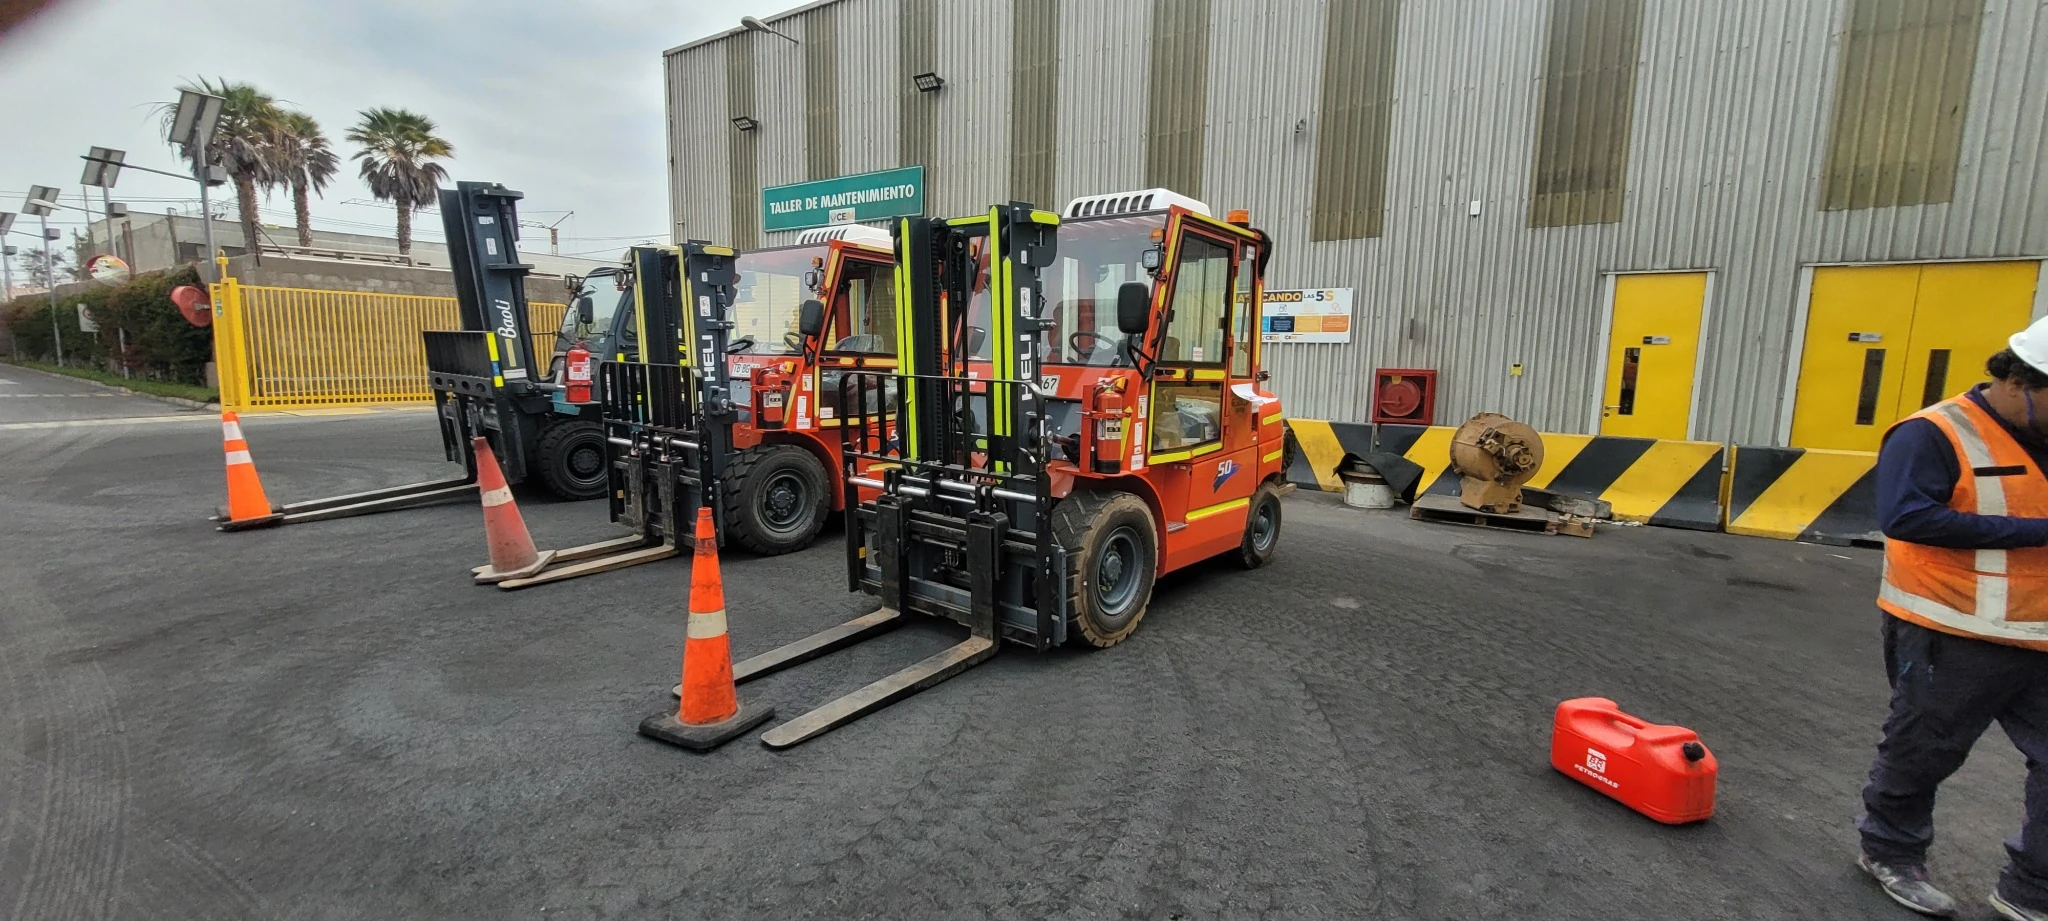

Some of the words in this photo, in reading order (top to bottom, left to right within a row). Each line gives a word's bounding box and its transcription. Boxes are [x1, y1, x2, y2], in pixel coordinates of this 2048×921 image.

[770, 199, 802, 215] TALLER
[805, 196, 818, 210] DE
[821, 184, 915, 209] MANTENIMIENTO
[495, 299, 517, 339] Baoli
[701, 334, 716, 382] HELI
[1020, 334, 1033, 401] HELI
[1043, 377, 1058, 391] 67
[1217, 459, 1233, 478] 50
